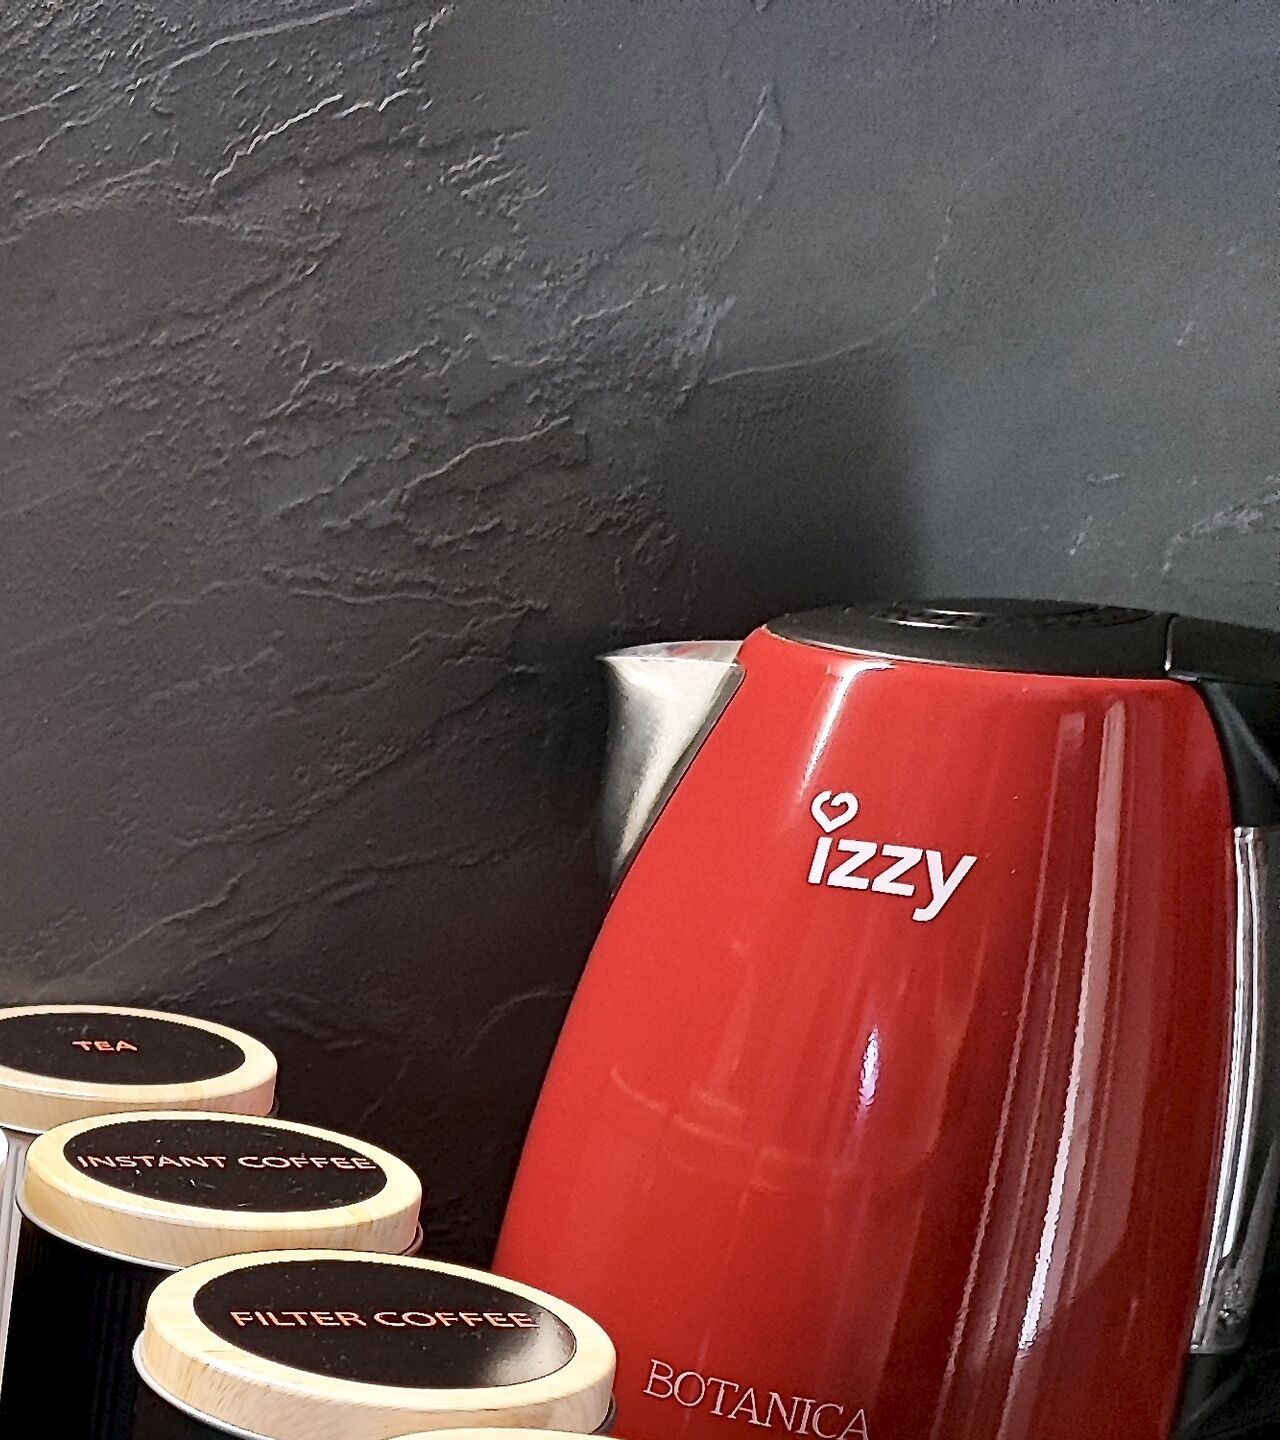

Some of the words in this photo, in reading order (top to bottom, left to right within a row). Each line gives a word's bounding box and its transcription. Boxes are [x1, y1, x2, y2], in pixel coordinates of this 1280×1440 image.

[807, 790, 978, 922] izzy
[71, 1039, 138, 1052] TEA
[76, 1155, 227, 1169] INSTANT
[238, 1156, 377, 1171] COFFEE
[229, 1311, 367, 1327] FILTER
[373, 1311, 540, 1328] COFFEE
